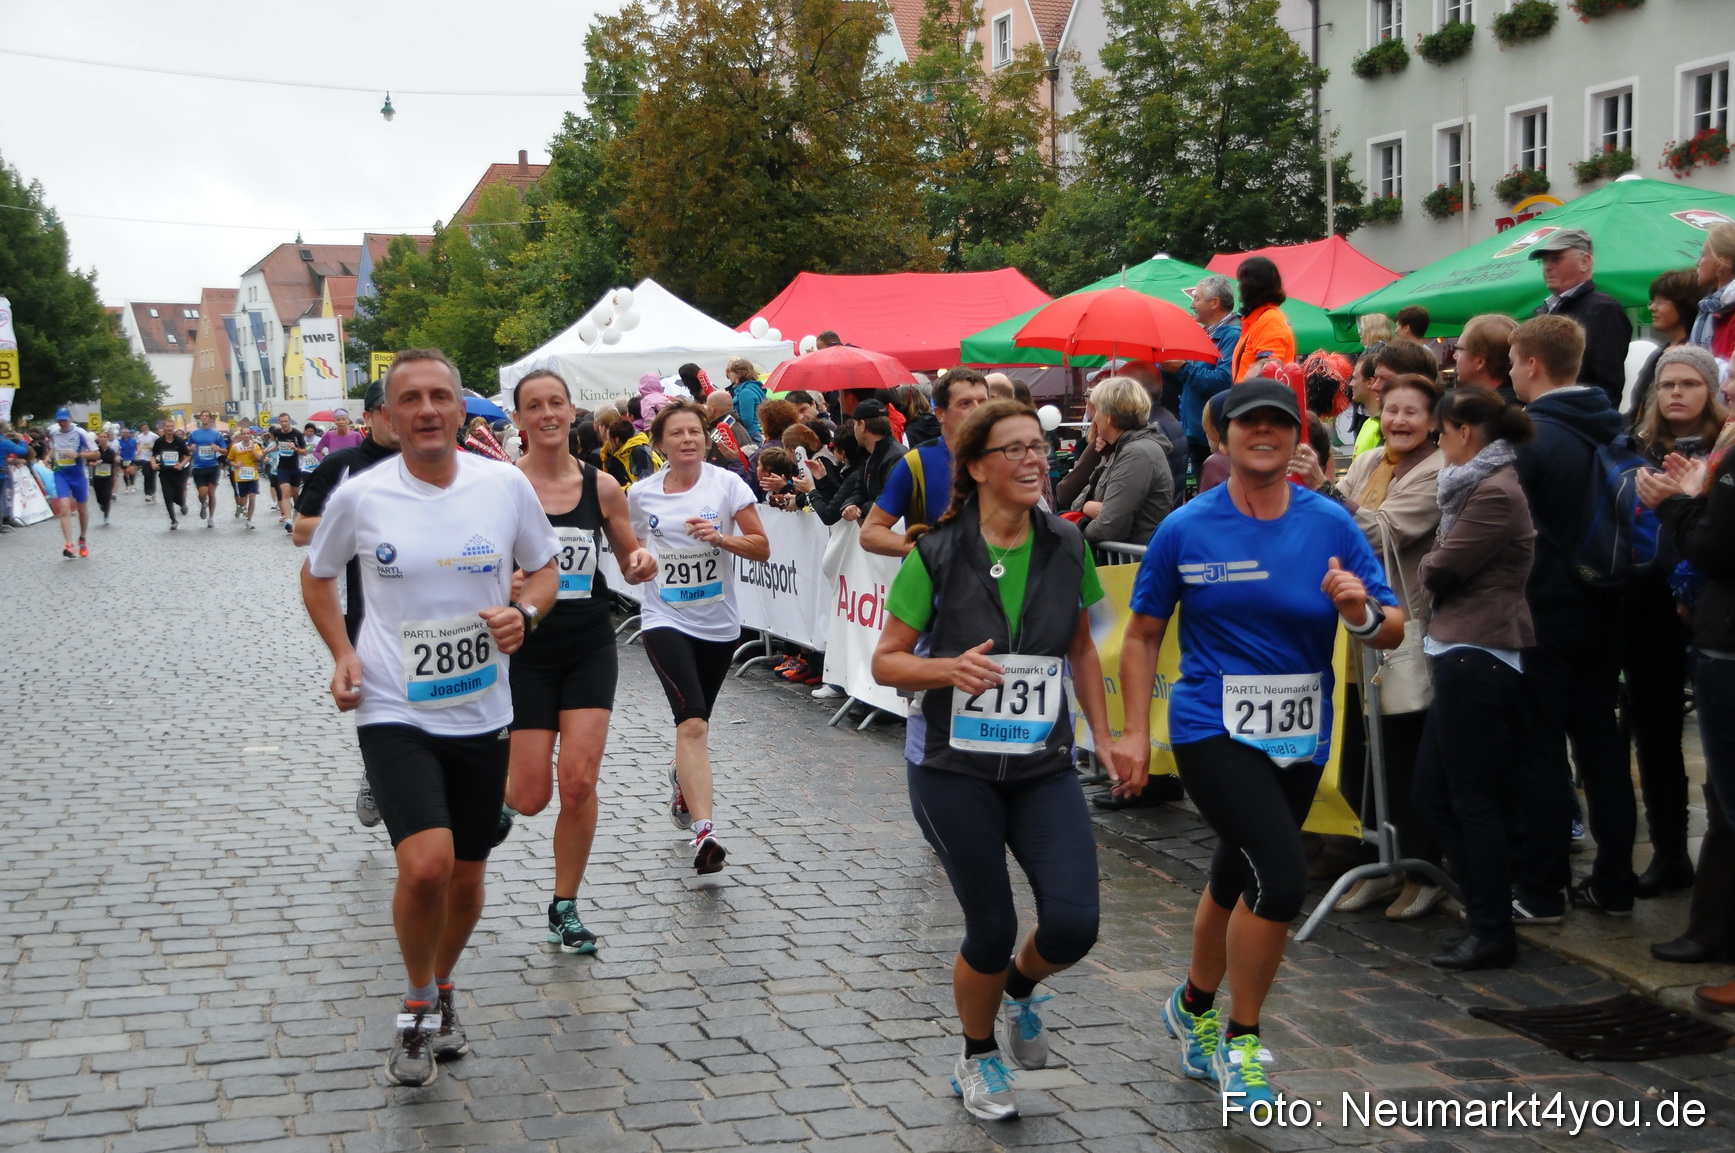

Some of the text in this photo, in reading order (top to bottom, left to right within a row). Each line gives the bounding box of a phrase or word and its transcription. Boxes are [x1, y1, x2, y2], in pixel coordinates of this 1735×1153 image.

[580, 388, 621, 400] Kinder
[90, 416, 98, 426] C
[554, 545, 591, 571] 37
[679, 552, 711, 560] Neumarkt
[377, 566, 403, 574] PARTL
[664, 559, 717, 584] 2912
[680, 589, 705, 599] Maria
[404, 622, 484, 639] PARTL Neumarkt
[414, 632, 490, 676] 2886
[1003, 665, 1044, 674] eumarkt
[430, 677, 482, 697] Joachim
[1225, 685, 1310, 694] PARTL Neumarkt
[1235, 696, 1314, 734] 2130
[980, 723, 1030, 741] Brigitte
